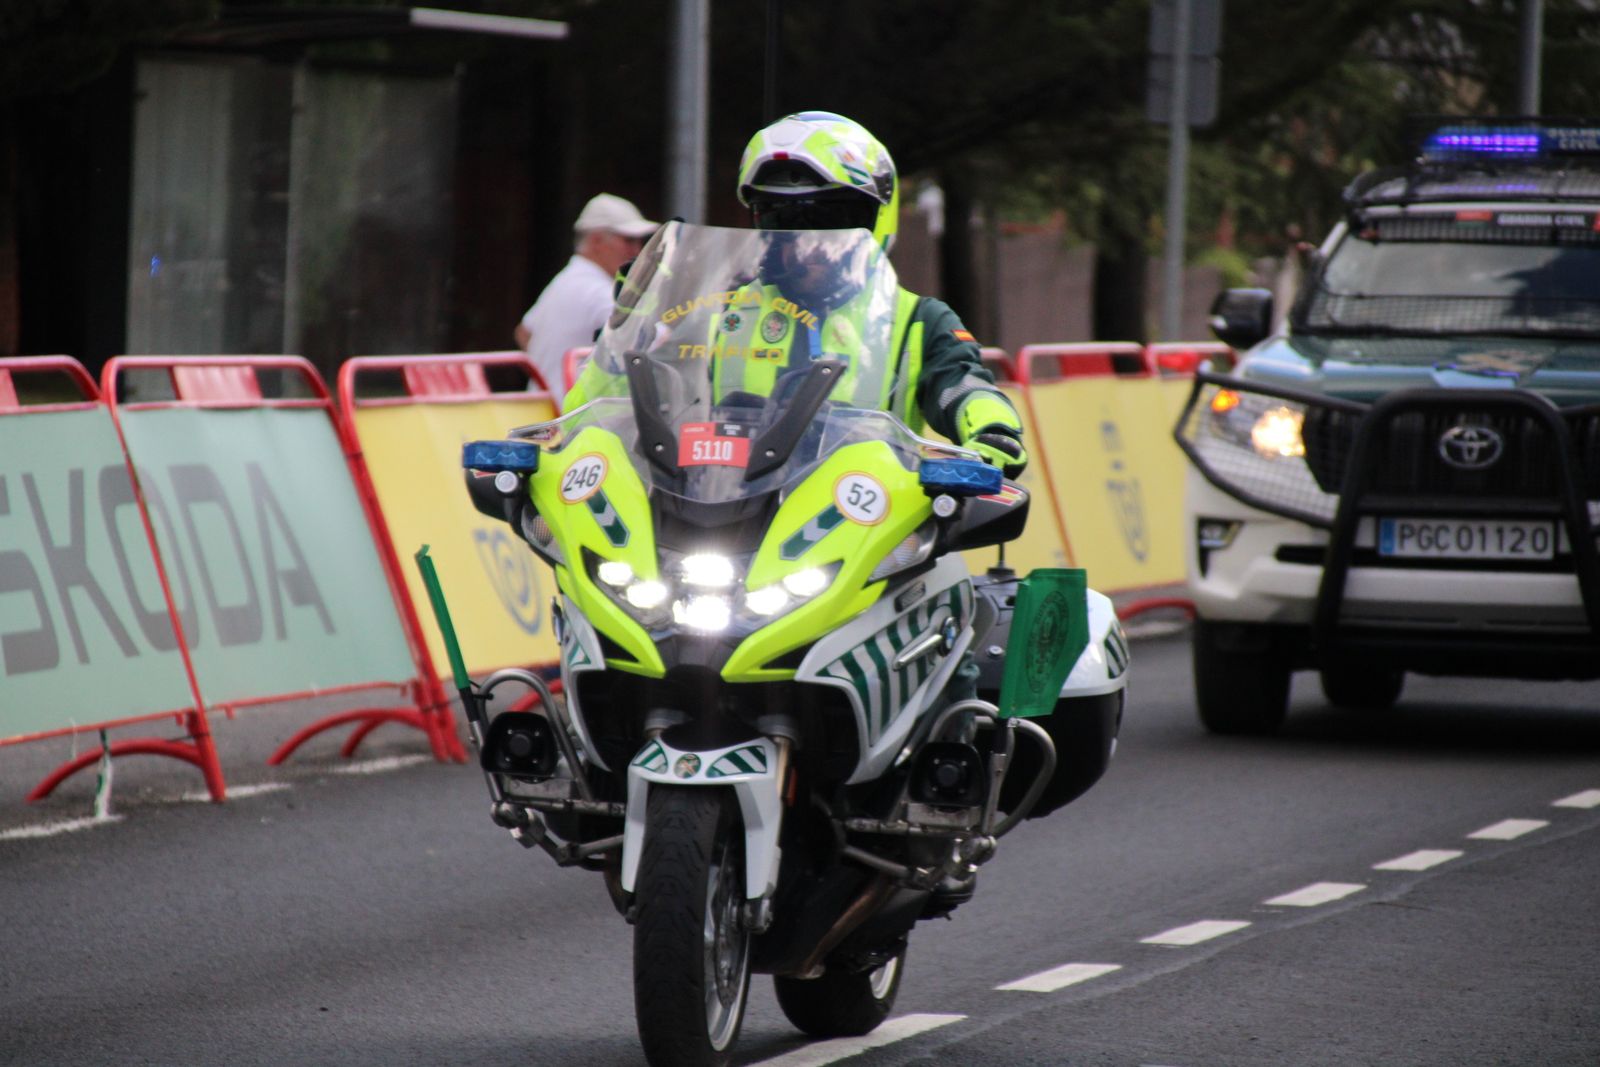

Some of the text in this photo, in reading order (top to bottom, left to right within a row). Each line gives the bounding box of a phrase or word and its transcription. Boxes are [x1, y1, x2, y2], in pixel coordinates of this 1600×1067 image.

[771, 297, 819, 331] CIVIL
[692, 440, 733, 461] 5110
[562, 464, 602, 492] 246
[847, 482, 878, 514] 52
